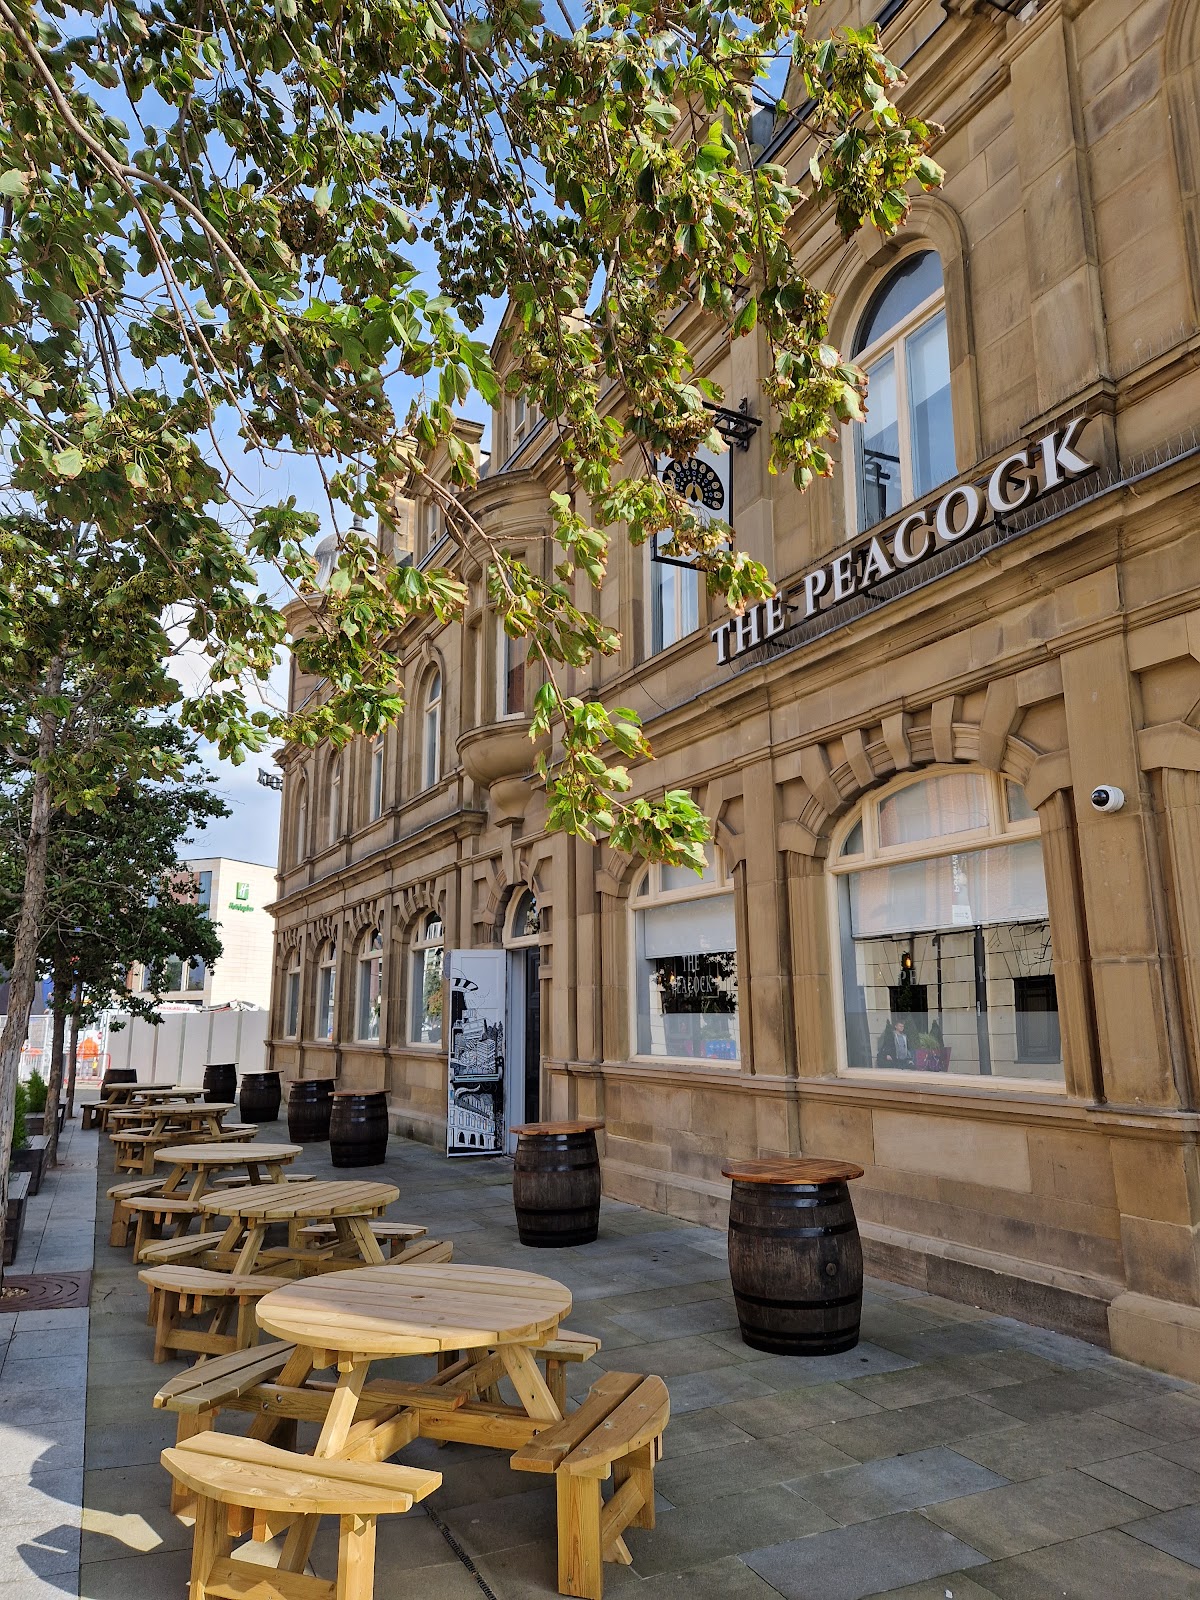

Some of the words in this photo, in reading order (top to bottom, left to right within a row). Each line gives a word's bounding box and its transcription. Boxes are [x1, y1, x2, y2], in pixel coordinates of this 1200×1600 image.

[712, 591, 786, 665] THE
[803, 416, 1093, 619] PEACOCK
[682, 954, 701, 972] THE
